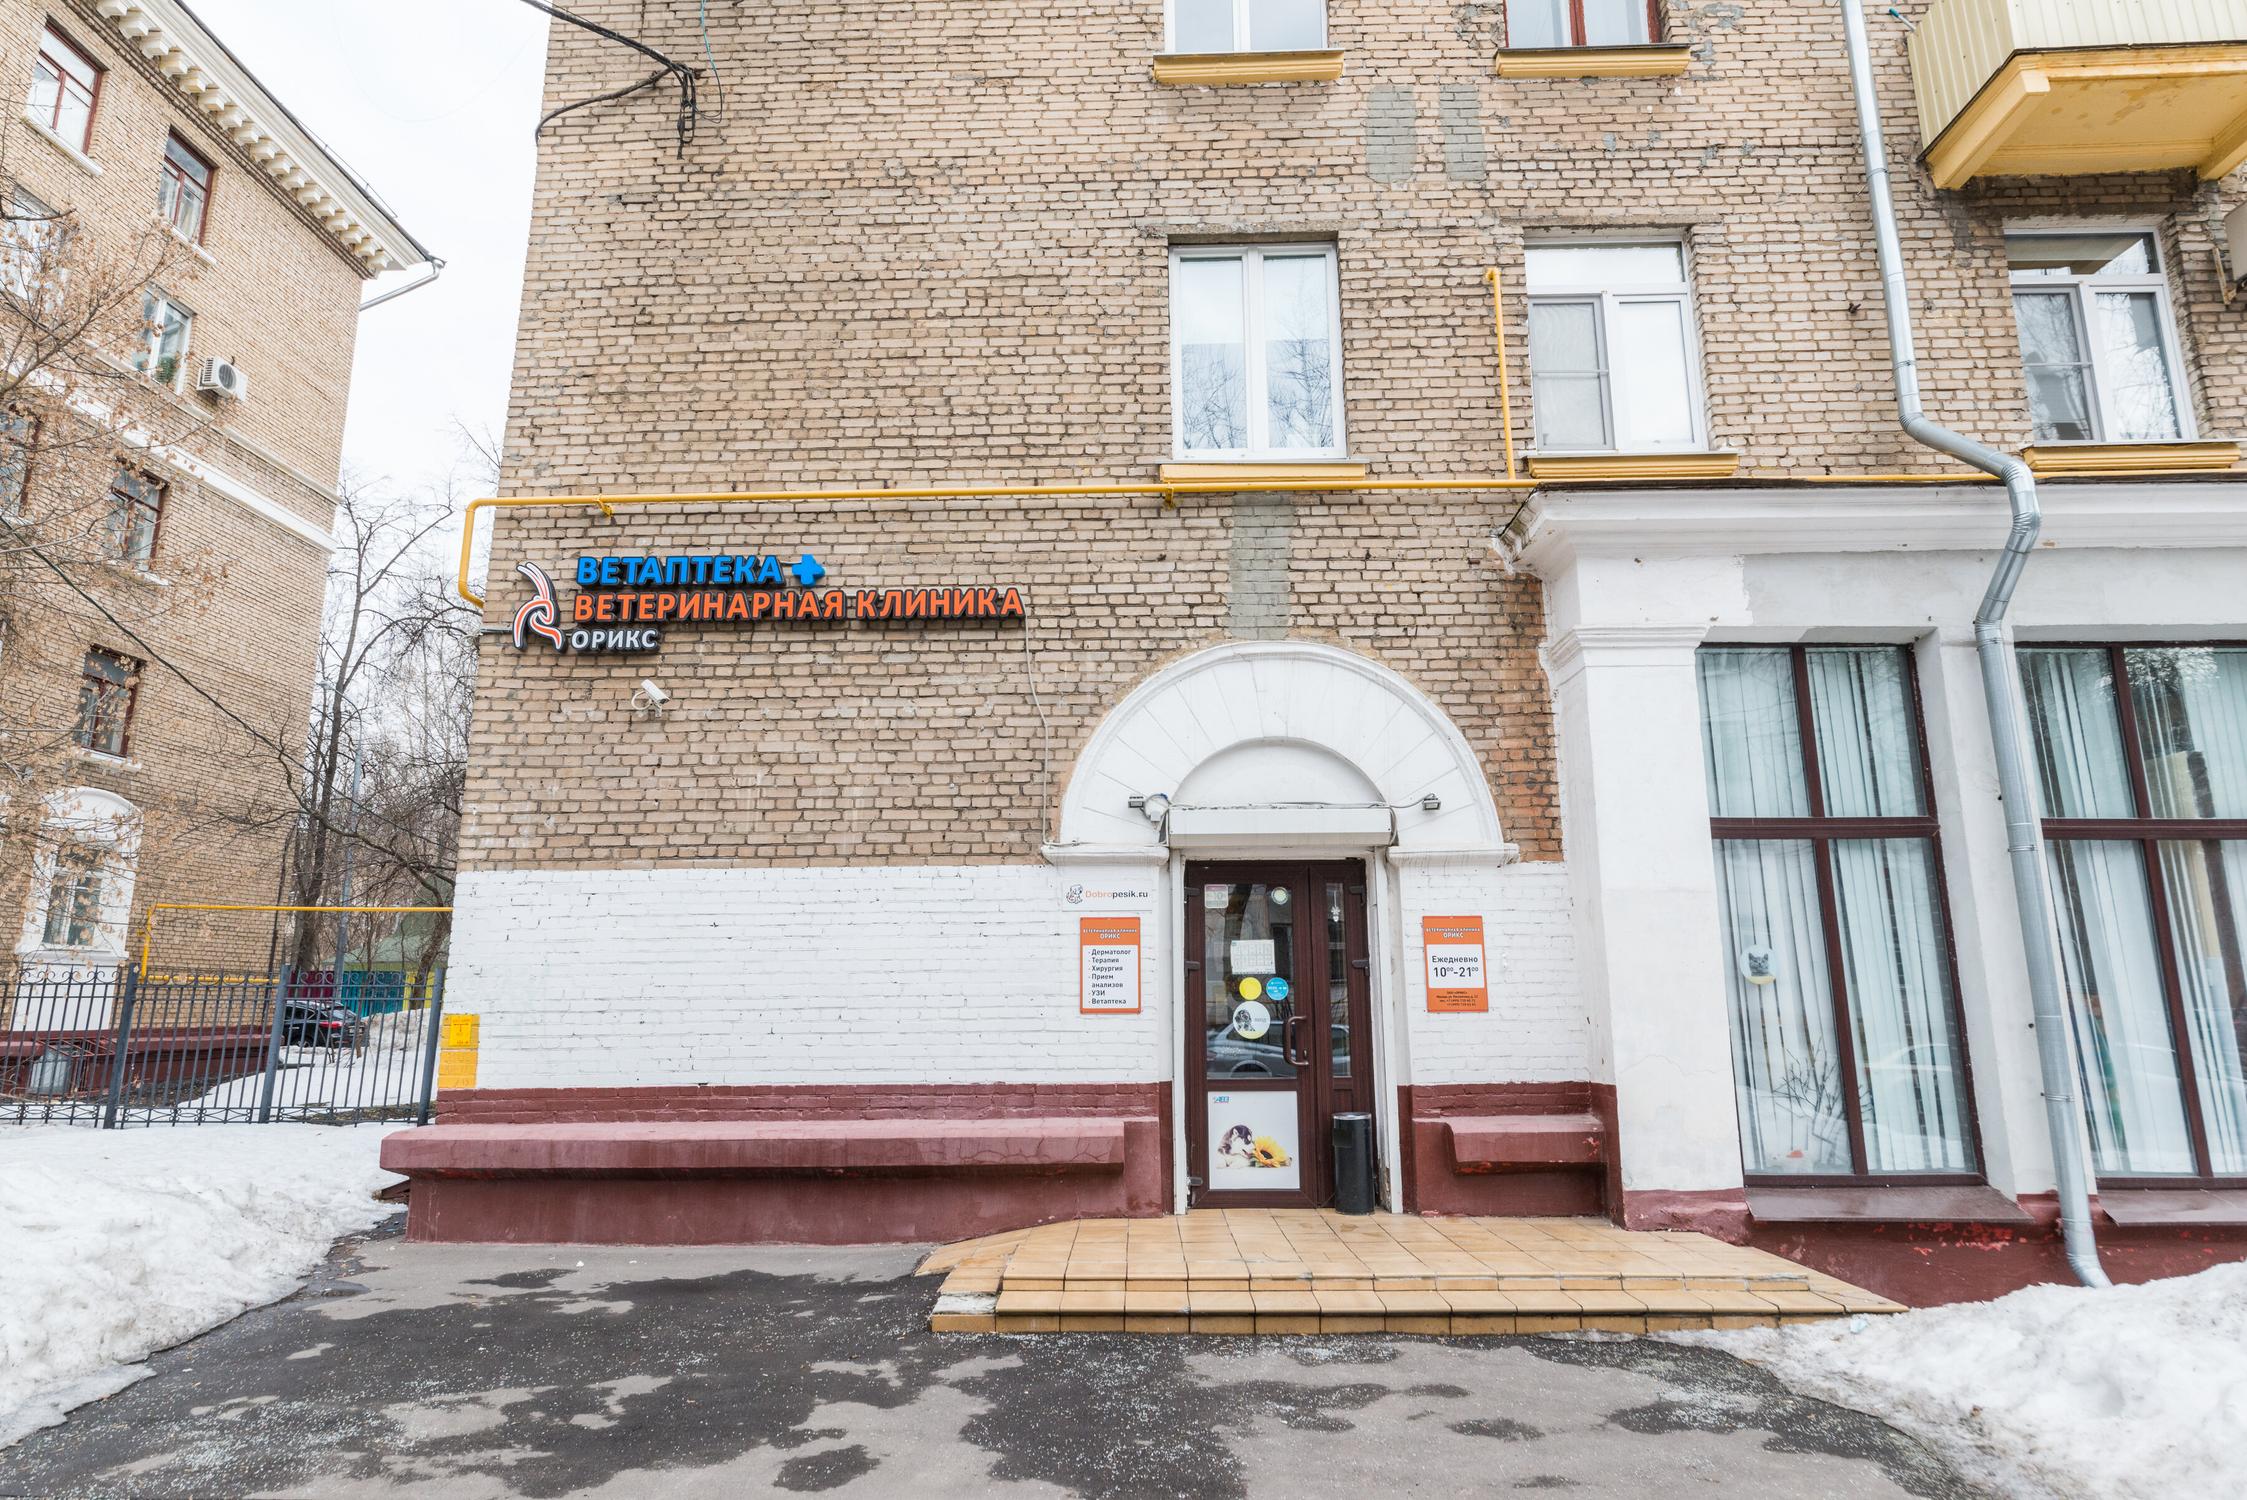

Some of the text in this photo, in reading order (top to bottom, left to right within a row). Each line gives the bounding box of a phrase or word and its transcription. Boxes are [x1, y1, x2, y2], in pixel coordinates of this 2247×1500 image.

[576, 555, 784, 585] ВЕТАПТЕКА
[574, 588, 1024, 621] ВЕТЕРИНАРНАЯ КЛИНИКА
[571, 629, 657, 649] ОРИКС
[1085, 889, 1149, 899] Dobropesik.ru
[1431, 955, 1479, 963] Ежедневно
[1091, 973, 1114, 981] Прием
